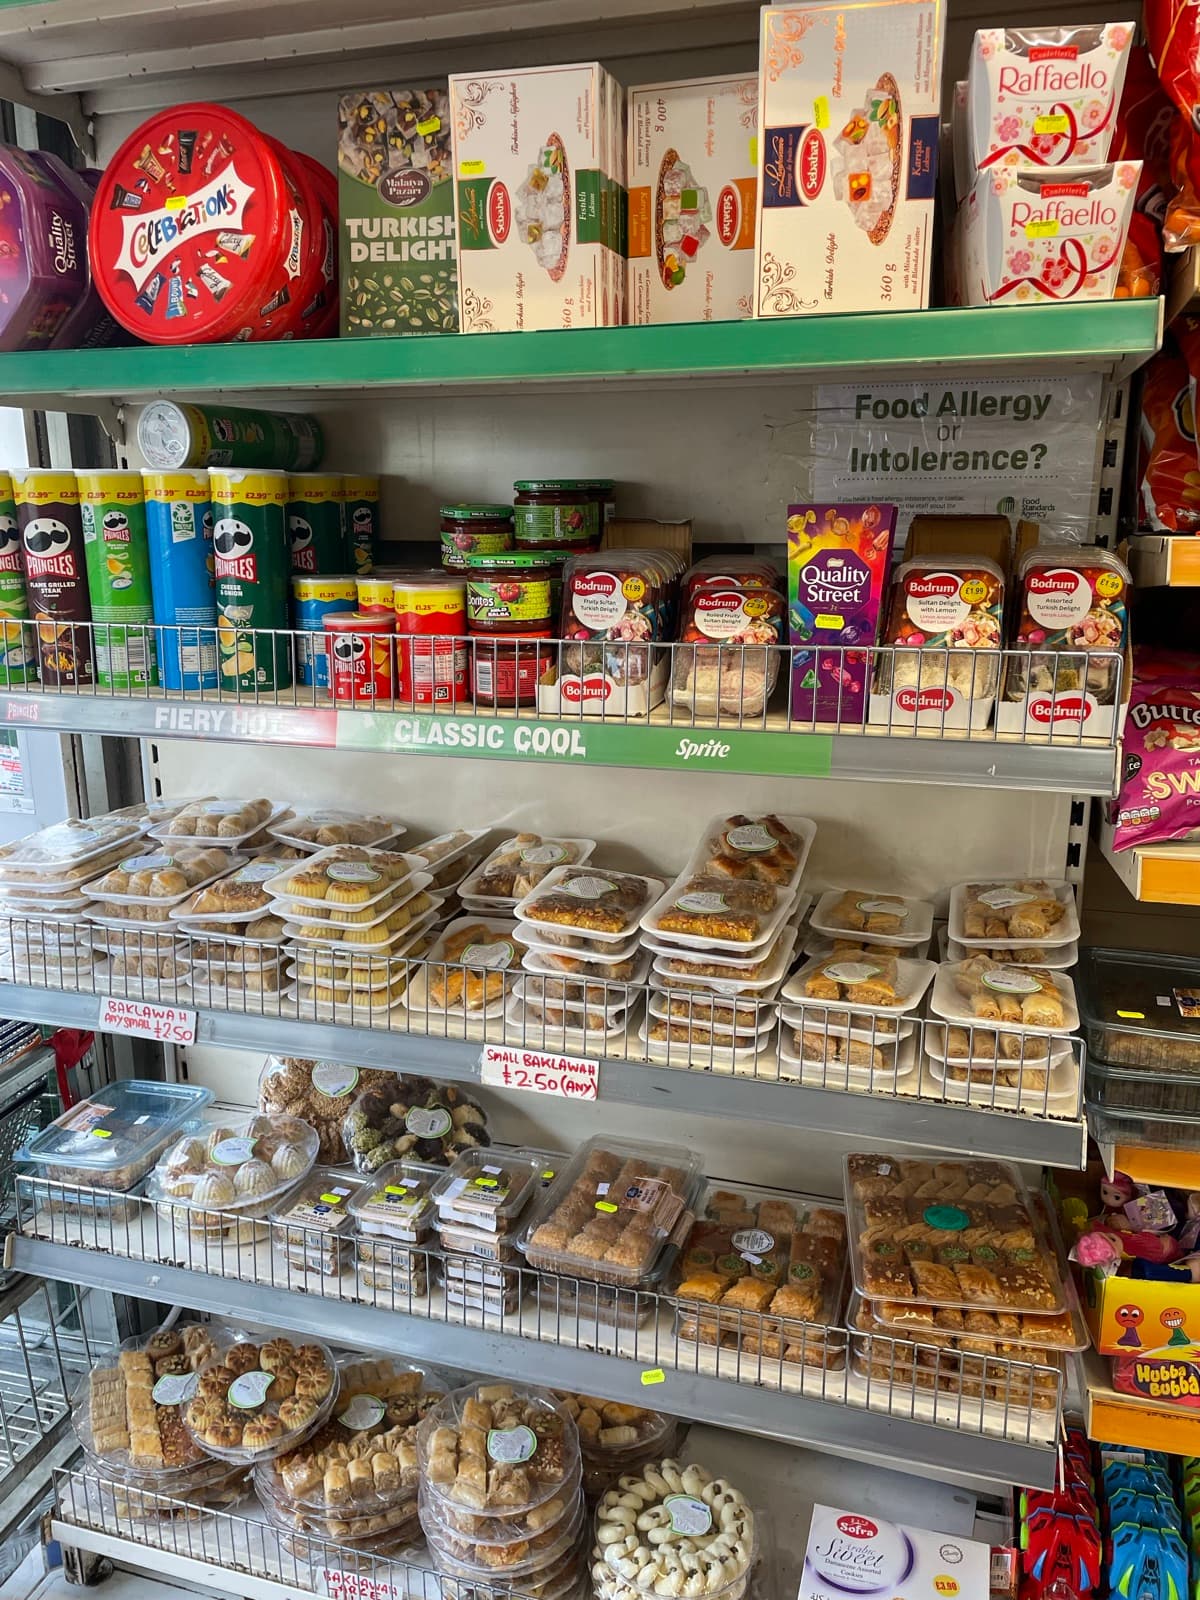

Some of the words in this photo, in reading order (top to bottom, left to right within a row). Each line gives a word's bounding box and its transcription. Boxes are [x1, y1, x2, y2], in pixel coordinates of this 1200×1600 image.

[999, 64, 1107, 95] Raffaello
[656, 98, 666, 121] 400
[806, 139, 819, 189] Sebahat
[496, 191, 505, 235] Sebahat
[722, 194, 733, 238] Sebahat
[1011, 201, 1116, 227] Raffaello
[345, 216, 457, 239] TURKISH
[53, 211, 67, 273] Quality
[65, 221, 77, 270] Street
[350, 240, 457, 262] DELIGHT
[825, 232, 836, 265] Delight
[824, 268, 835, 300] Turkish
[881, 276, 892, 302] 360
[855, 394, 929, 419] Food
[936, 391, 1052, 421] Allergy
[937, 422, 960, 442] or
[850, 443, 1047, 472] Intolerance?
[103, 529, 131, 542] PRINGLES
[27, 555, 74, 577] PRINGLES
[215, 557, 254, 579] PRINGLES
[801, 565, 870, 590] Quality
[575, 580, 613, 591] Bodrum
[625, 584, 641, 592] £1.99
[807, 584, 862, 603] Street
[909, 582, 955, 593] Bodrum
[965, 587, 984, 595] £1.99
[1031, 578, 1075, 589] Bodrum
[698, 598, 738, 607] Bodrum
[901, 693, 950, 708] Bodrum
[1034, 703, 1088, 718] Bodrum
[155, 707, 226, 732] FIERY
[395, 720, 504, 749] CLASSIC
[514, 726, 586, 757] COOL
[675, 738, 731, 759] Sprite
[487, 1049, 519, 1064] SMALL
[523, 1054, 596, 1075] BAKLAWAH
[1136, 1364, 1187, 1384] Hubba
[1149, 1374, 1200, 1398] Bubba
[840, 1522, 874, 1537] Sofra
[815, 1538, 884, 1568] Sweet
